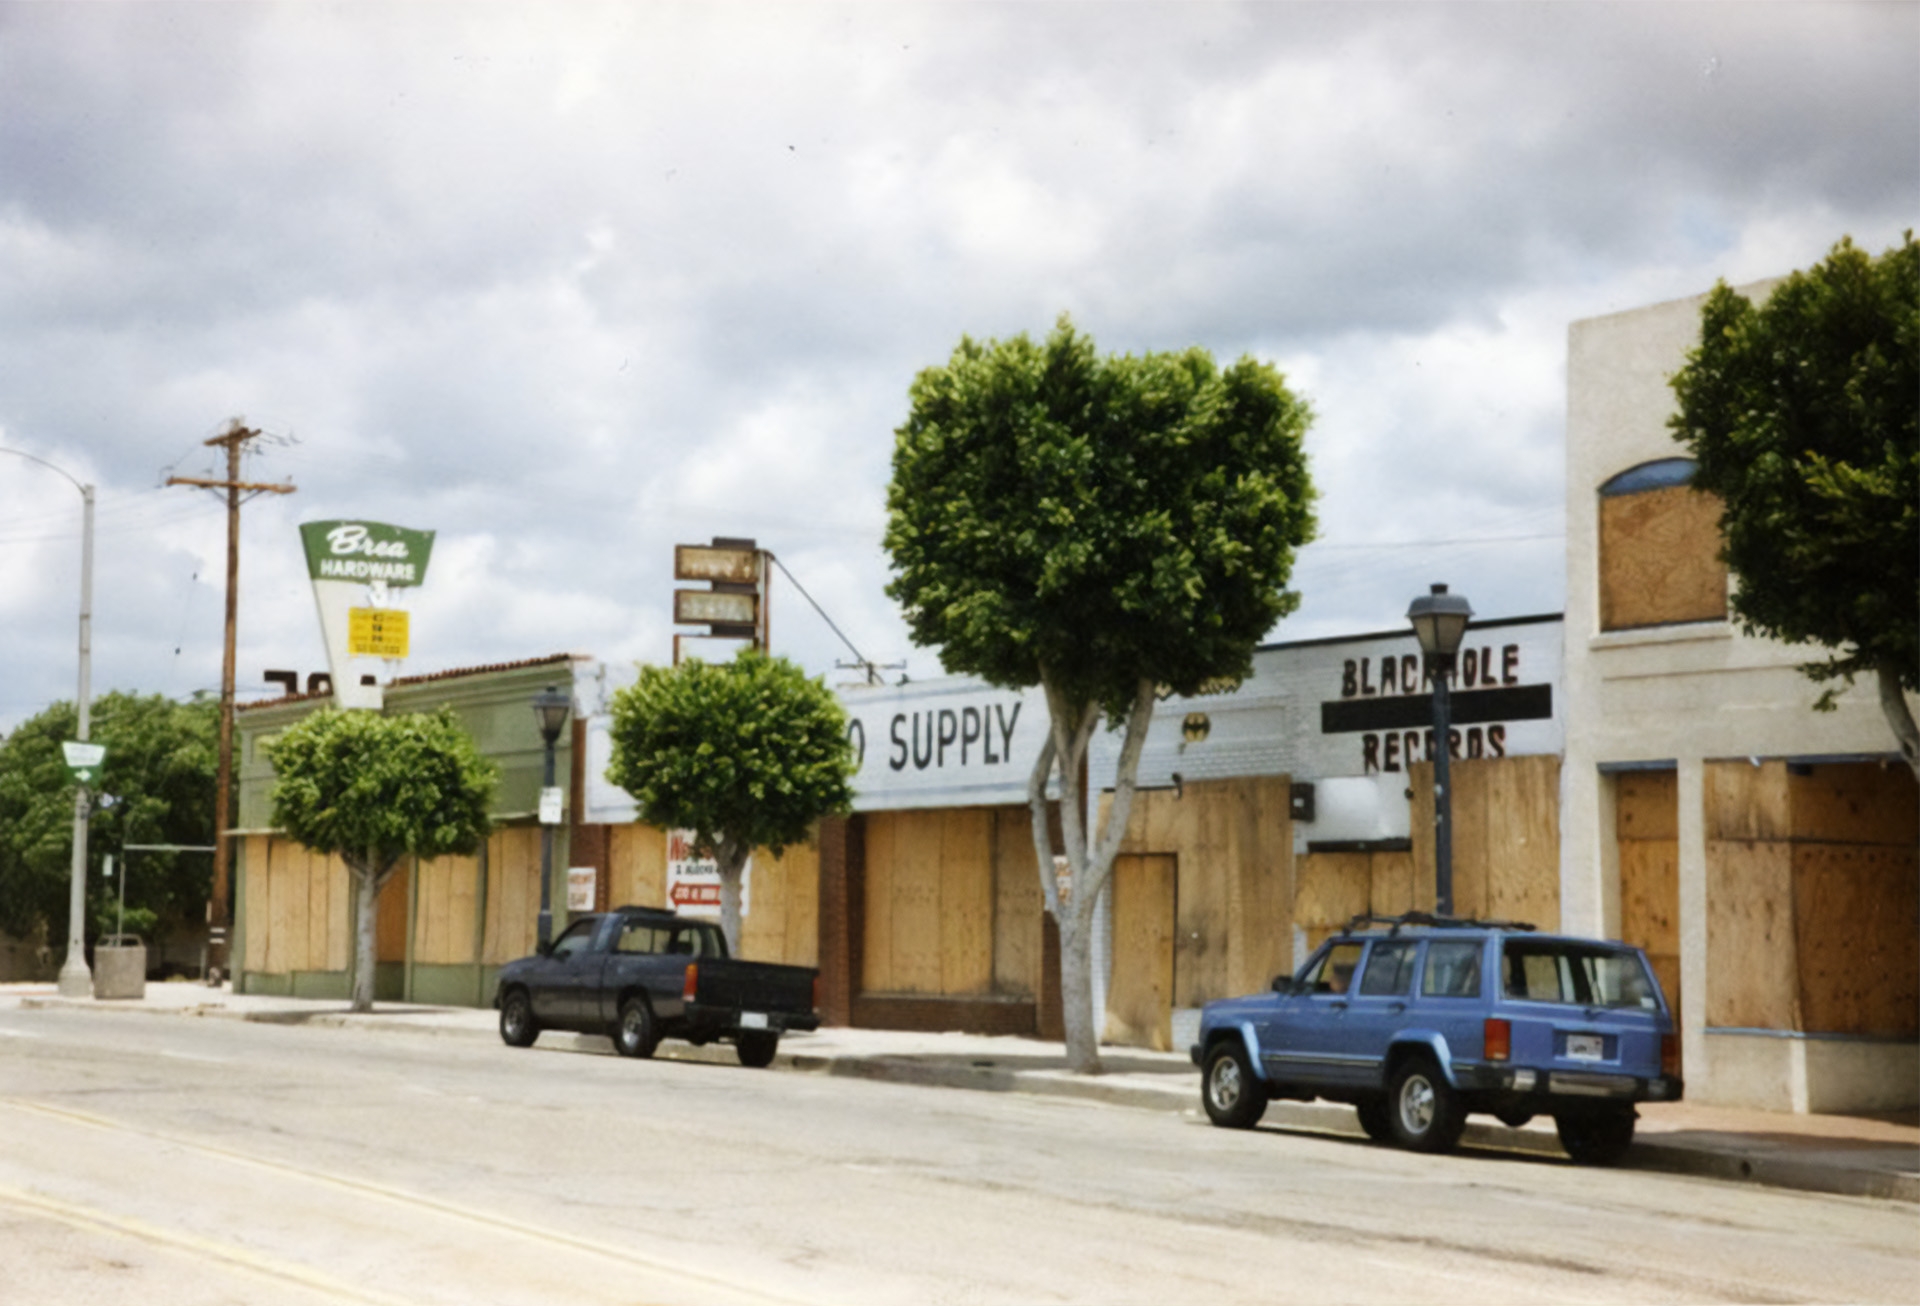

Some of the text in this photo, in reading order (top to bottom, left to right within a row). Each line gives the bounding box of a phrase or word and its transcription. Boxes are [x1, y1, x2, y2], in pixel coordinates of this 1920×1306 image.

[326, 525, 409, 558] Brea
[320, 559, 416, 580] HARDWARE
[889, 701, 1022, 771] SUPPLY
